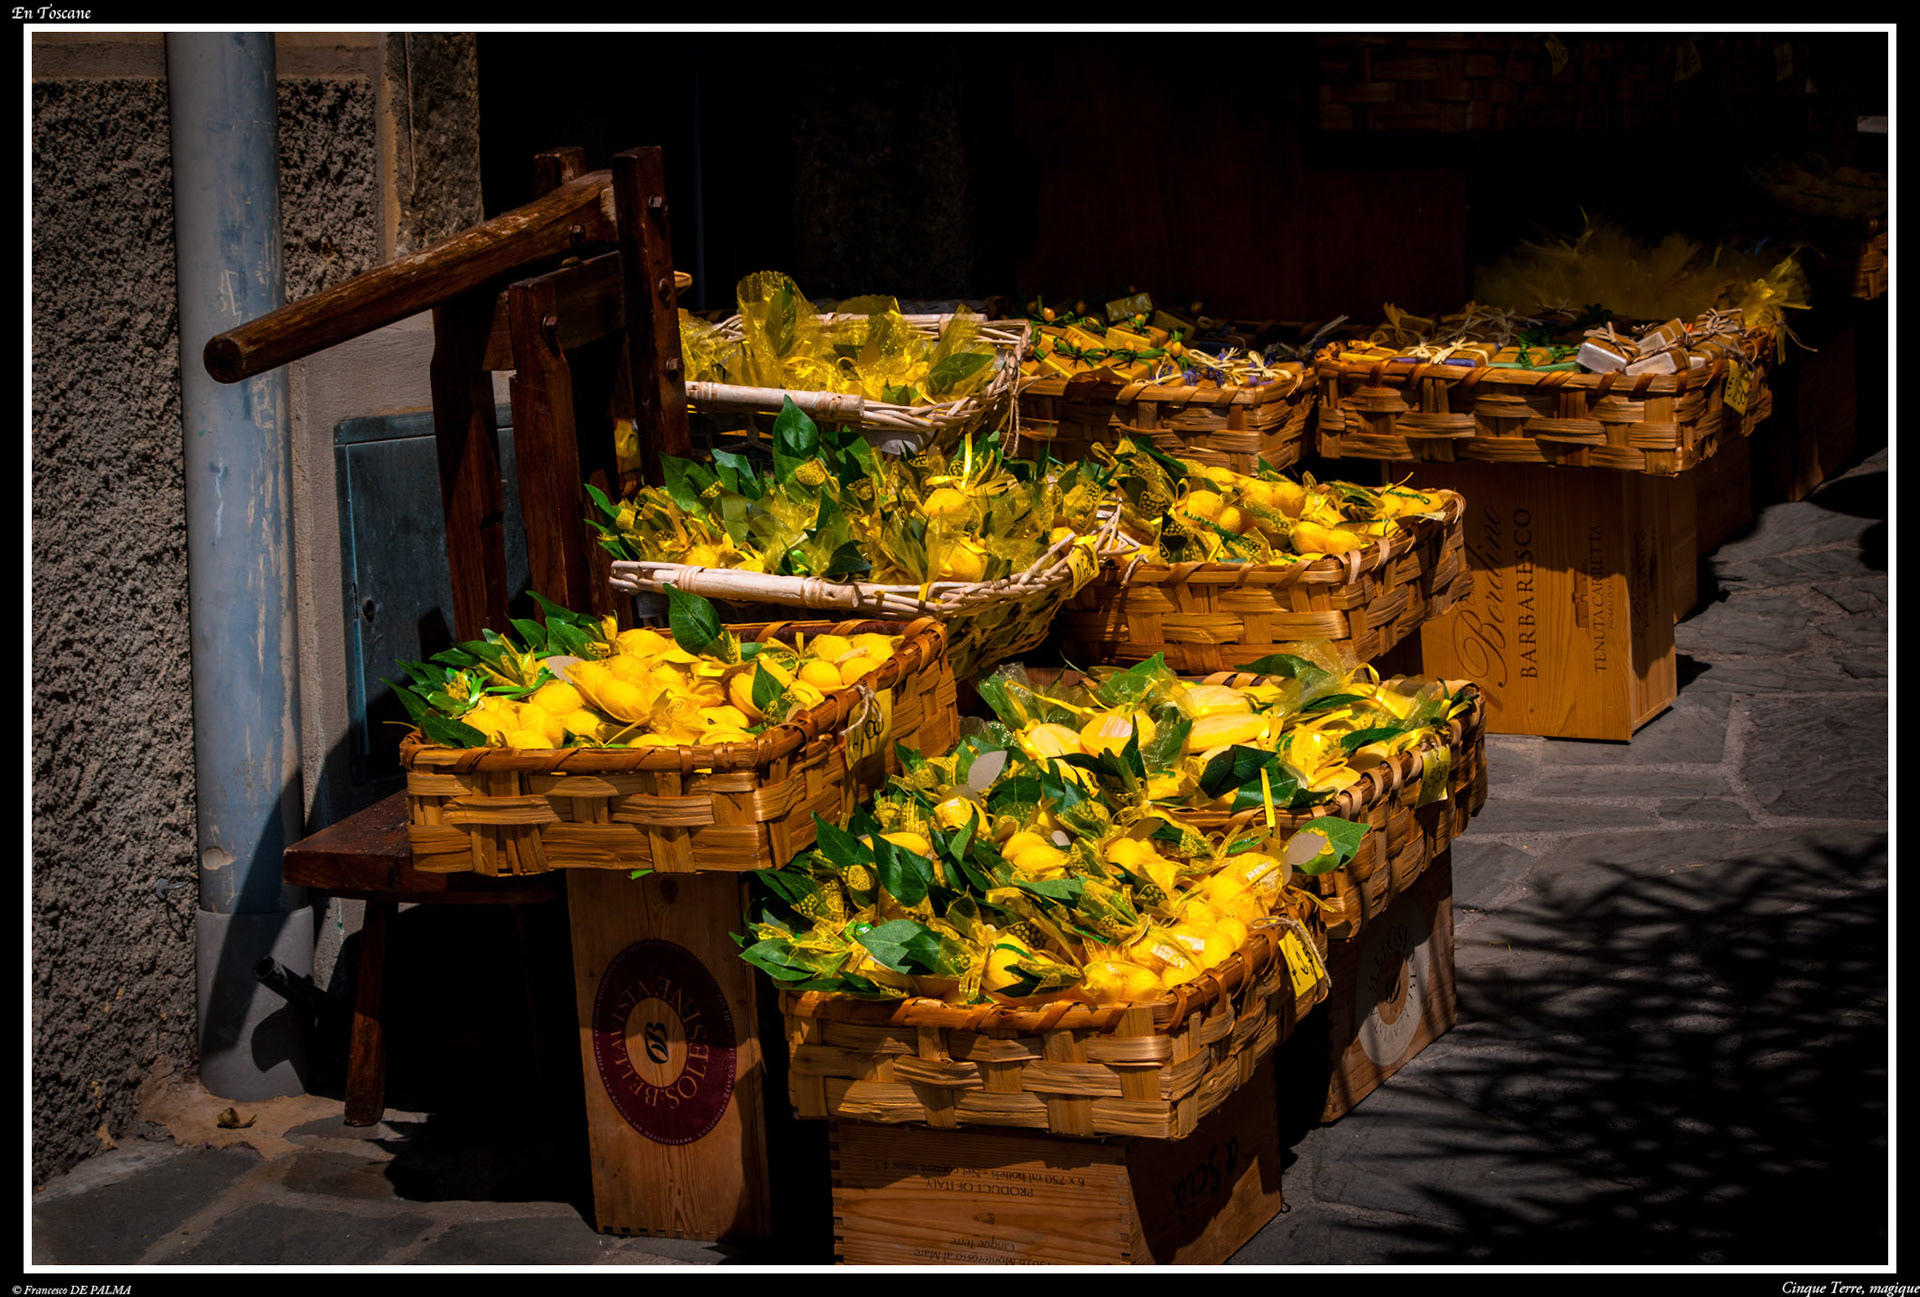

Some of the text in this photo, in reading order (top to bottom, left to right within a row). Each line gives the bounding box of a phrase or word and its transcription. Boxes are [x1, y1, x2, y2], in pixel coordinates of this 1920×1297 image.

[1513, 507, 1539, 679] BARBARESCO
[1588, 523, 1608, 674] TENUTA CARRETTA
[1028, 1172, 1042, 1183] ml
[1045, 1174, 1065, 1186] 750
[1078, 1177, 1086, 1187] 6
[925, 1179, 1035, 1198] PRODUCT OF ITALY
[950, 1236, 1016, 1253] Cinque Terre
[914, 1248, 941, 1260] Mare
[943, 1251, 953, 1262] al
[955, 1253, 1016, 1265] Monterosso
